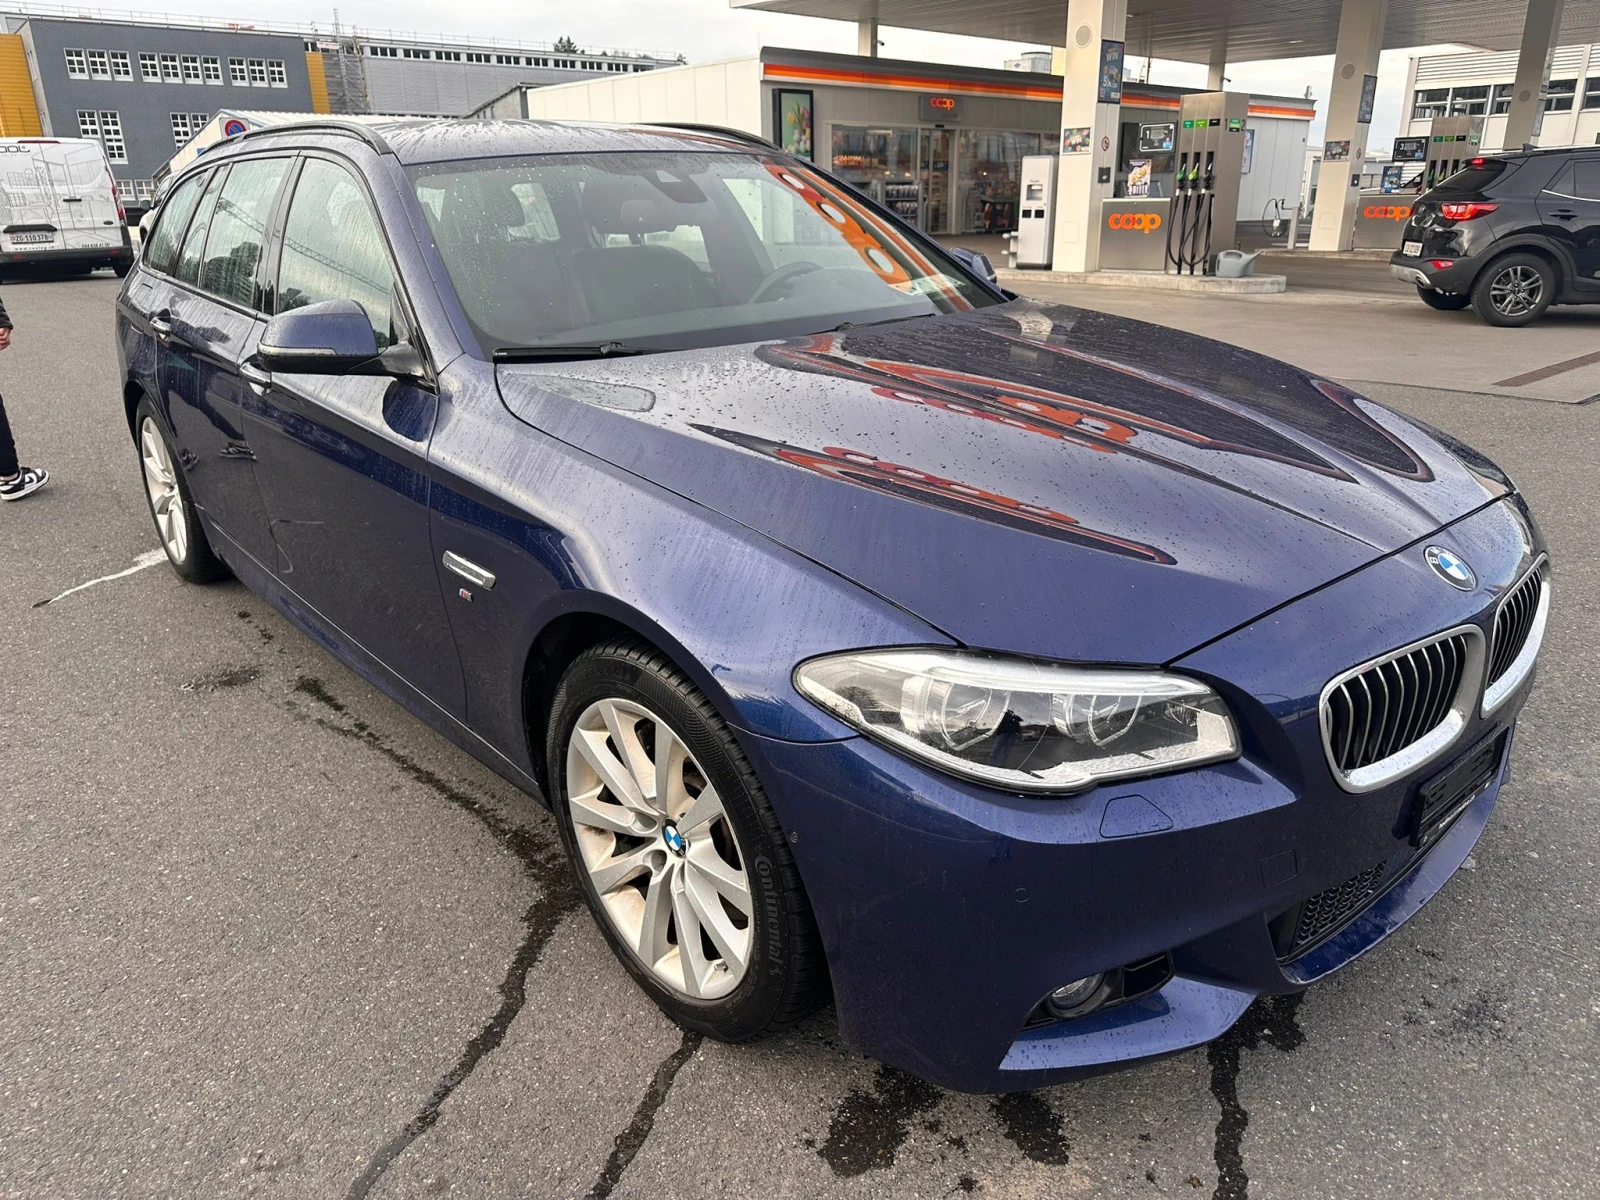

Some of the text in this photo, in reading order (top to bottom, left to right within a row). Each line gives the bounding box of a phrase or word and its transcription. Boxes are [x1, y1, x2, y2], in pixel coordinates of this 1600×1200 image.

[1106, 51, 1118, 61] WIN
[930, 97, 954, 111] coop
[1146, 130, 1150, 139] 1
[1400, 142, 1404, 150] 3
[1364, 205, 1411, 221] coop
[1108, 213, 1162, 234] coop
[755, 855, 783, 965] Continental
